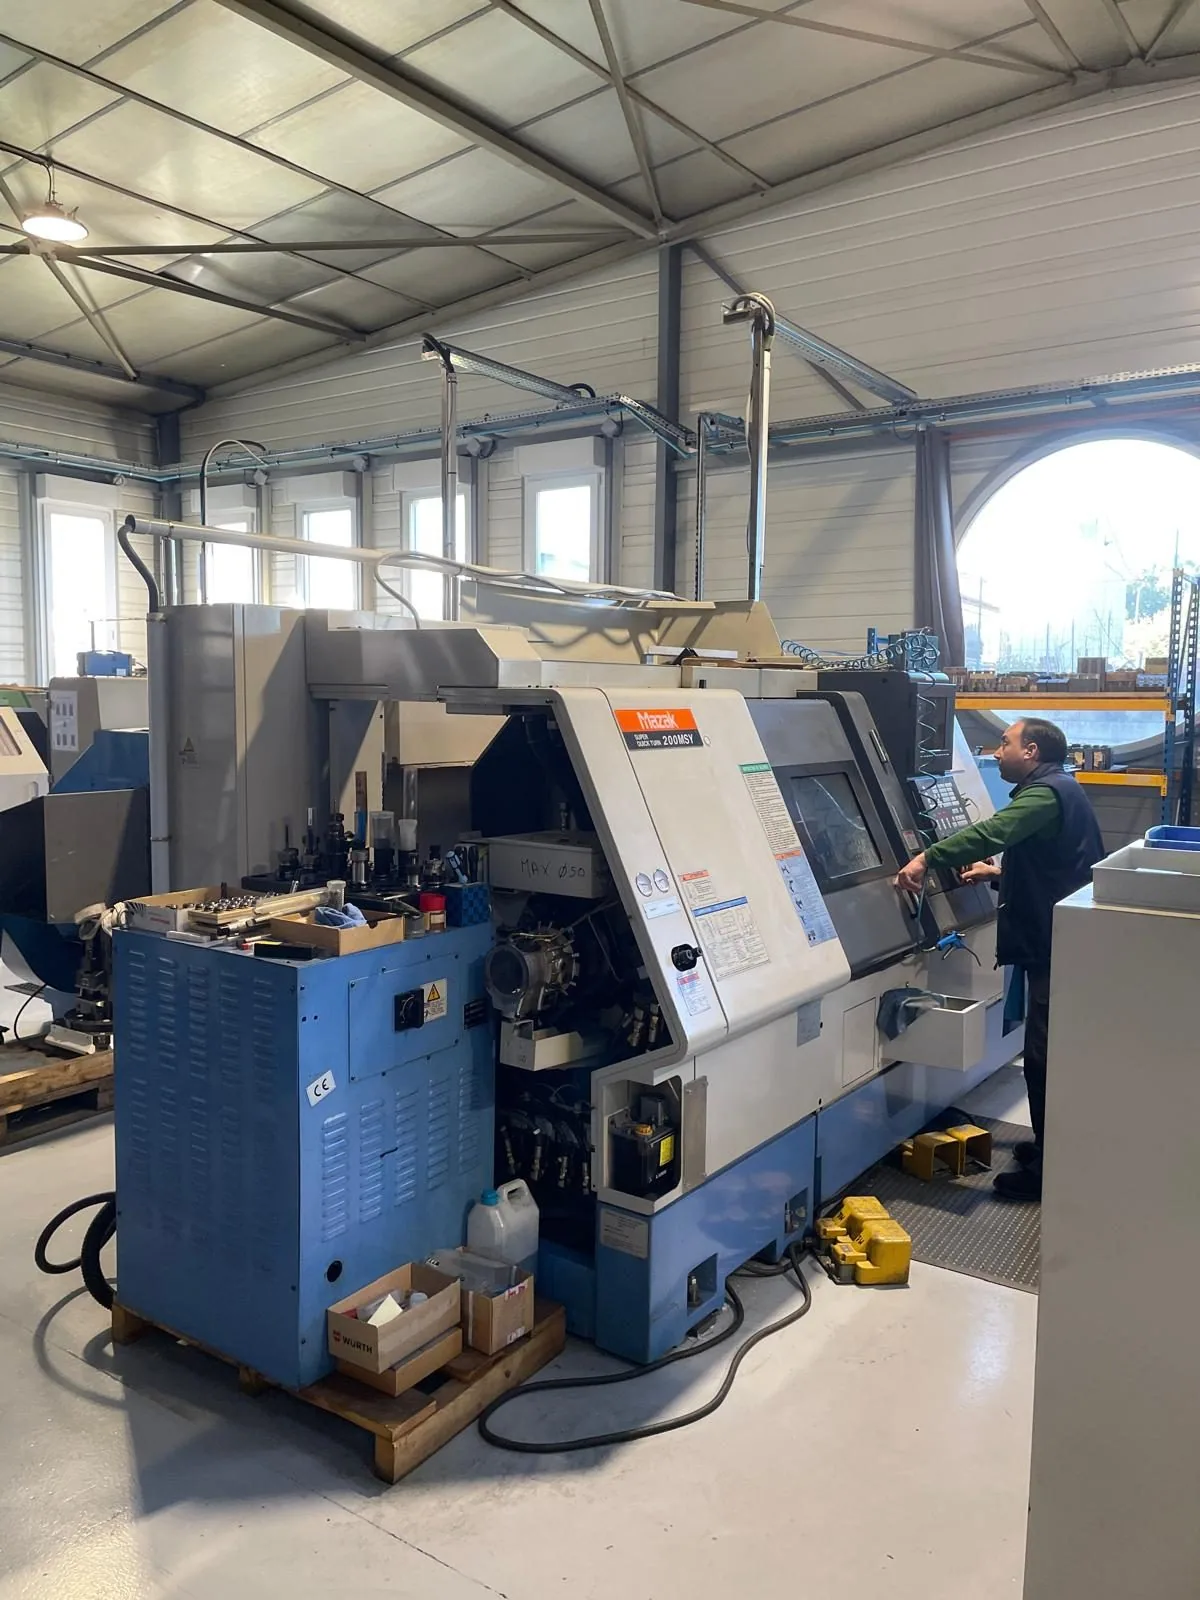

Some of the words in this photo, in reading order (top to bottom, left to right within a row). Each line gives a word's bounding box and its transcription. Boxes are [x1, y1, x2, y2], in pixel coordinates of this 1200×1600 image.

[637, 711, 679, 729] Mazak
[662, 734, 694, 746] 200MSY
[520, 859, 551, 879] MAX
[314, 1078, 330, 1097] CE
